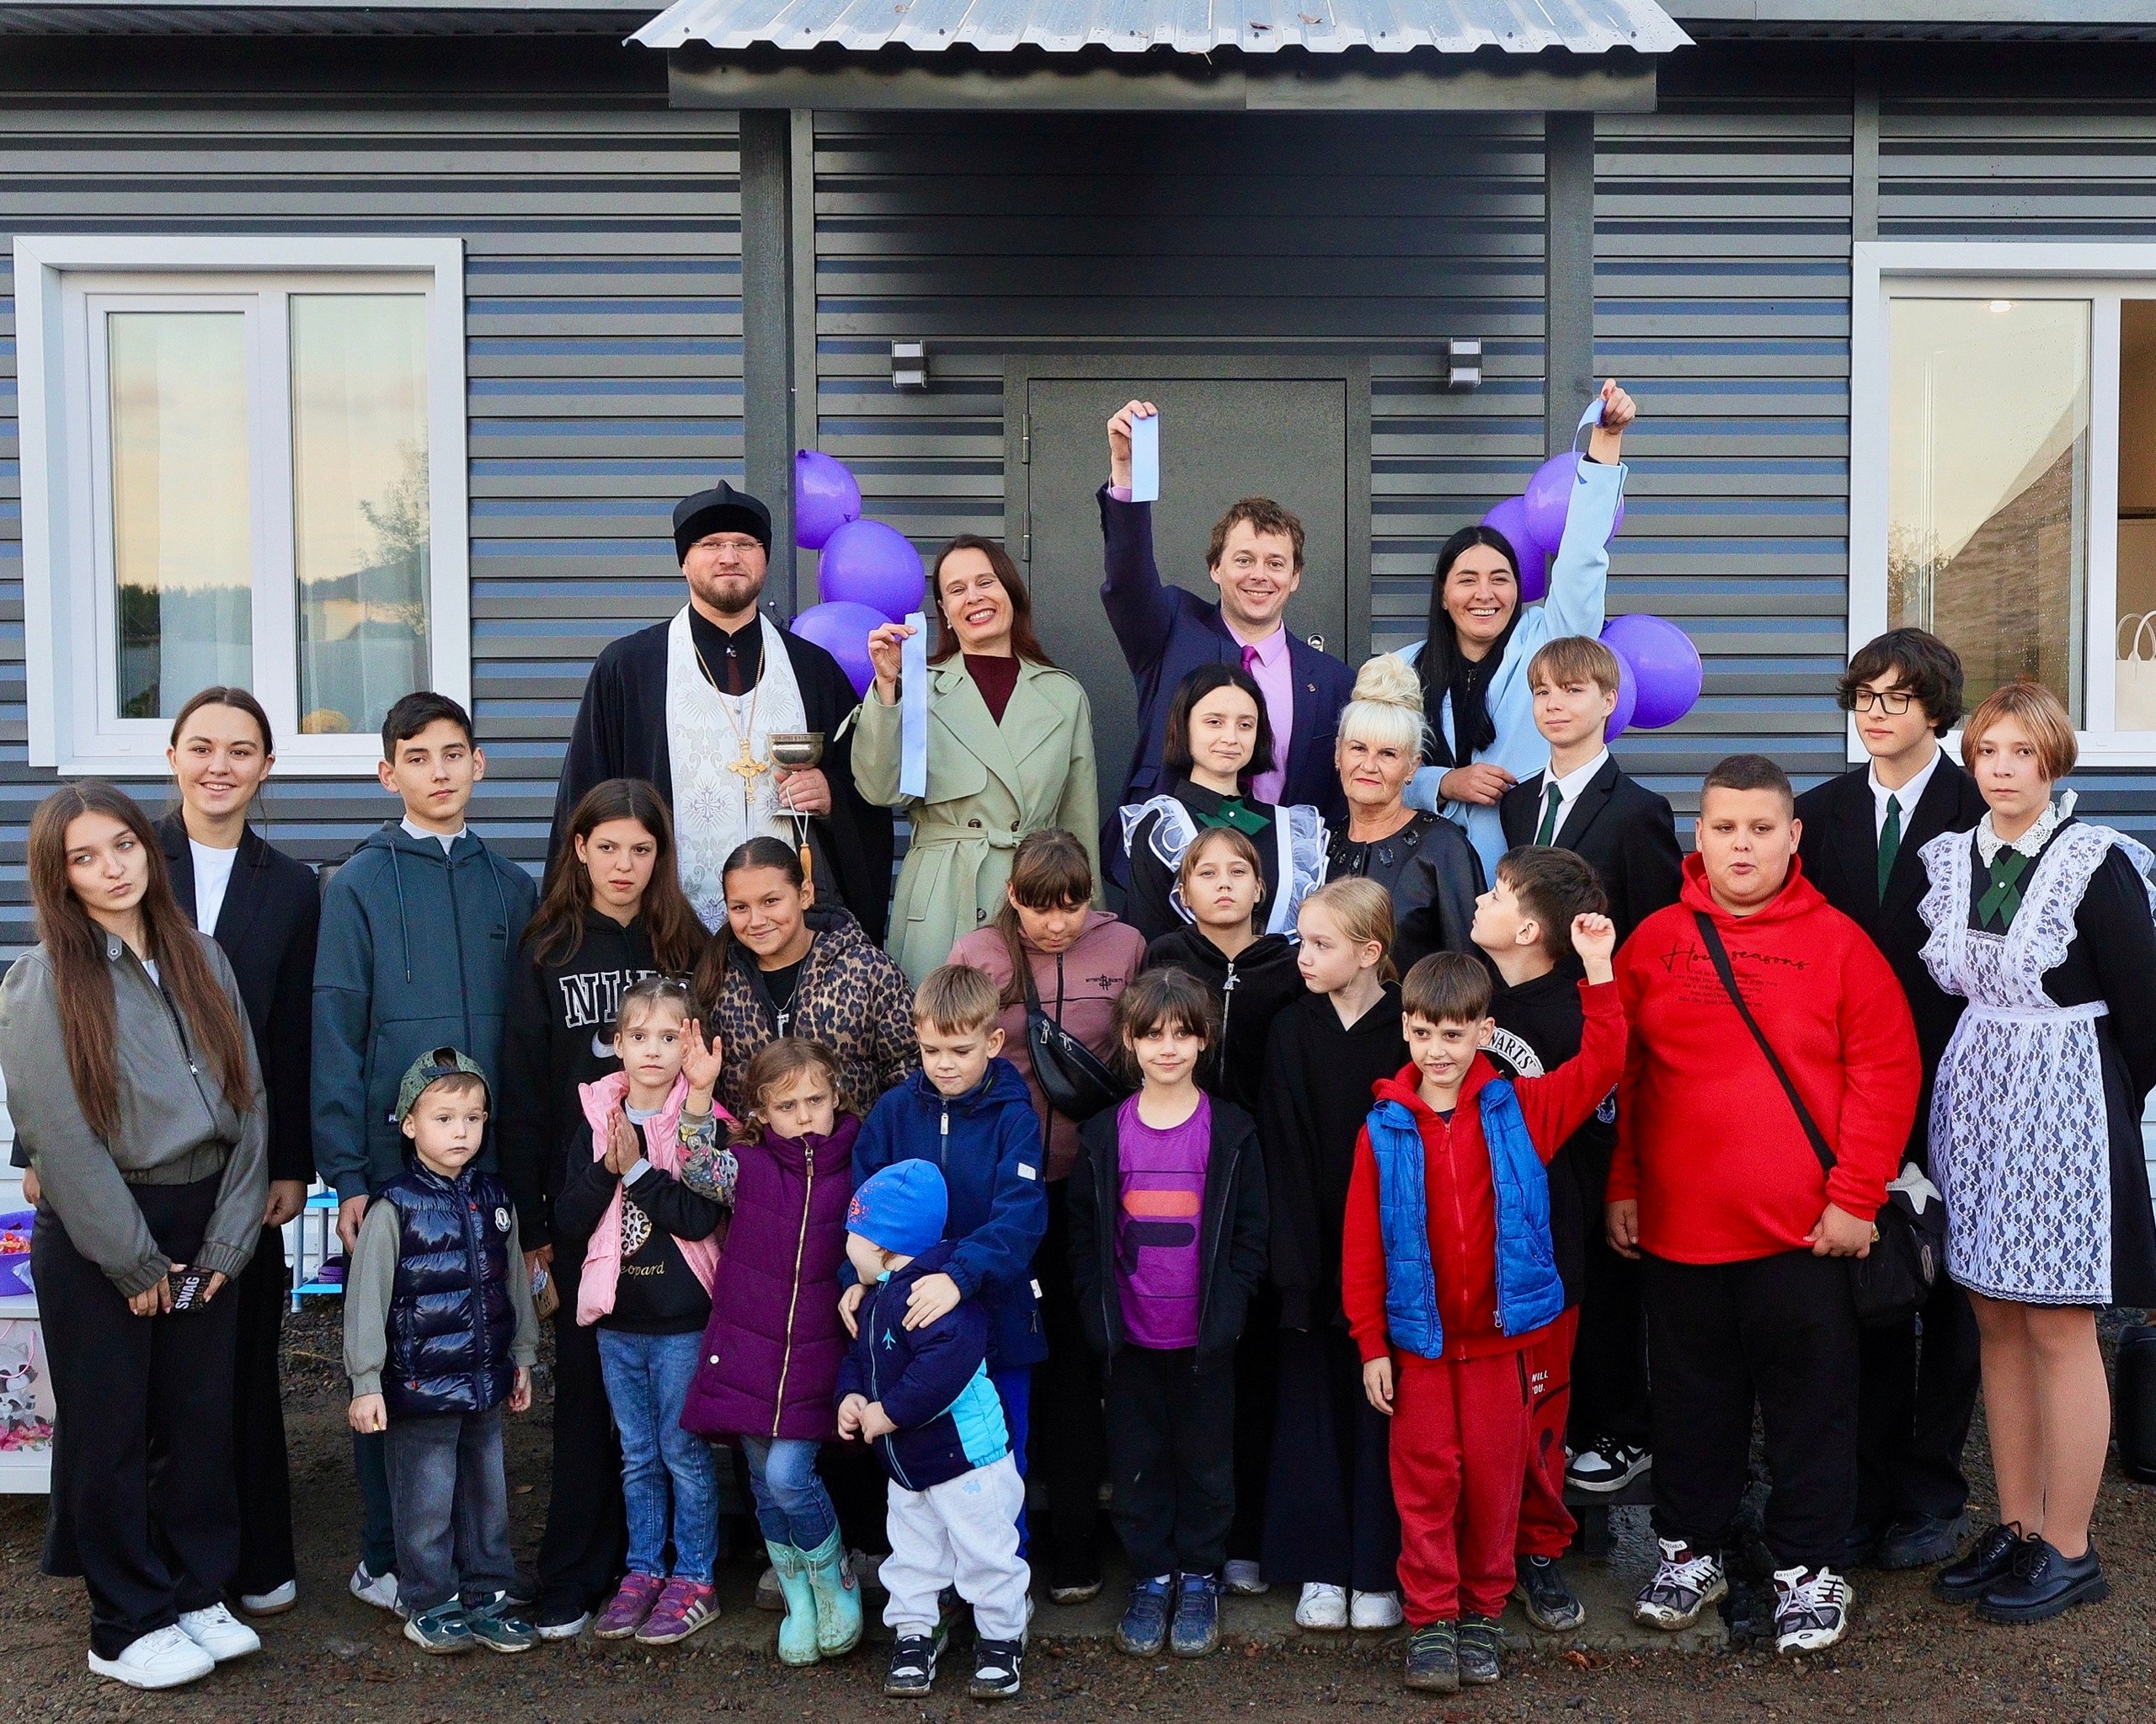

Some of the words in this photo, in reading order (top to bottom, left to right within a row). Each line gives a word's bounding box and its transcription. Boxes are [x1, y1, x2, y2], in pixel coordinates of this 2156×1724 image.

[1732, 949, 1811, 970] seasons
[175, 1277, 200, 1310] SWAG
[1532, 1384, 1545, 1395] OU.
